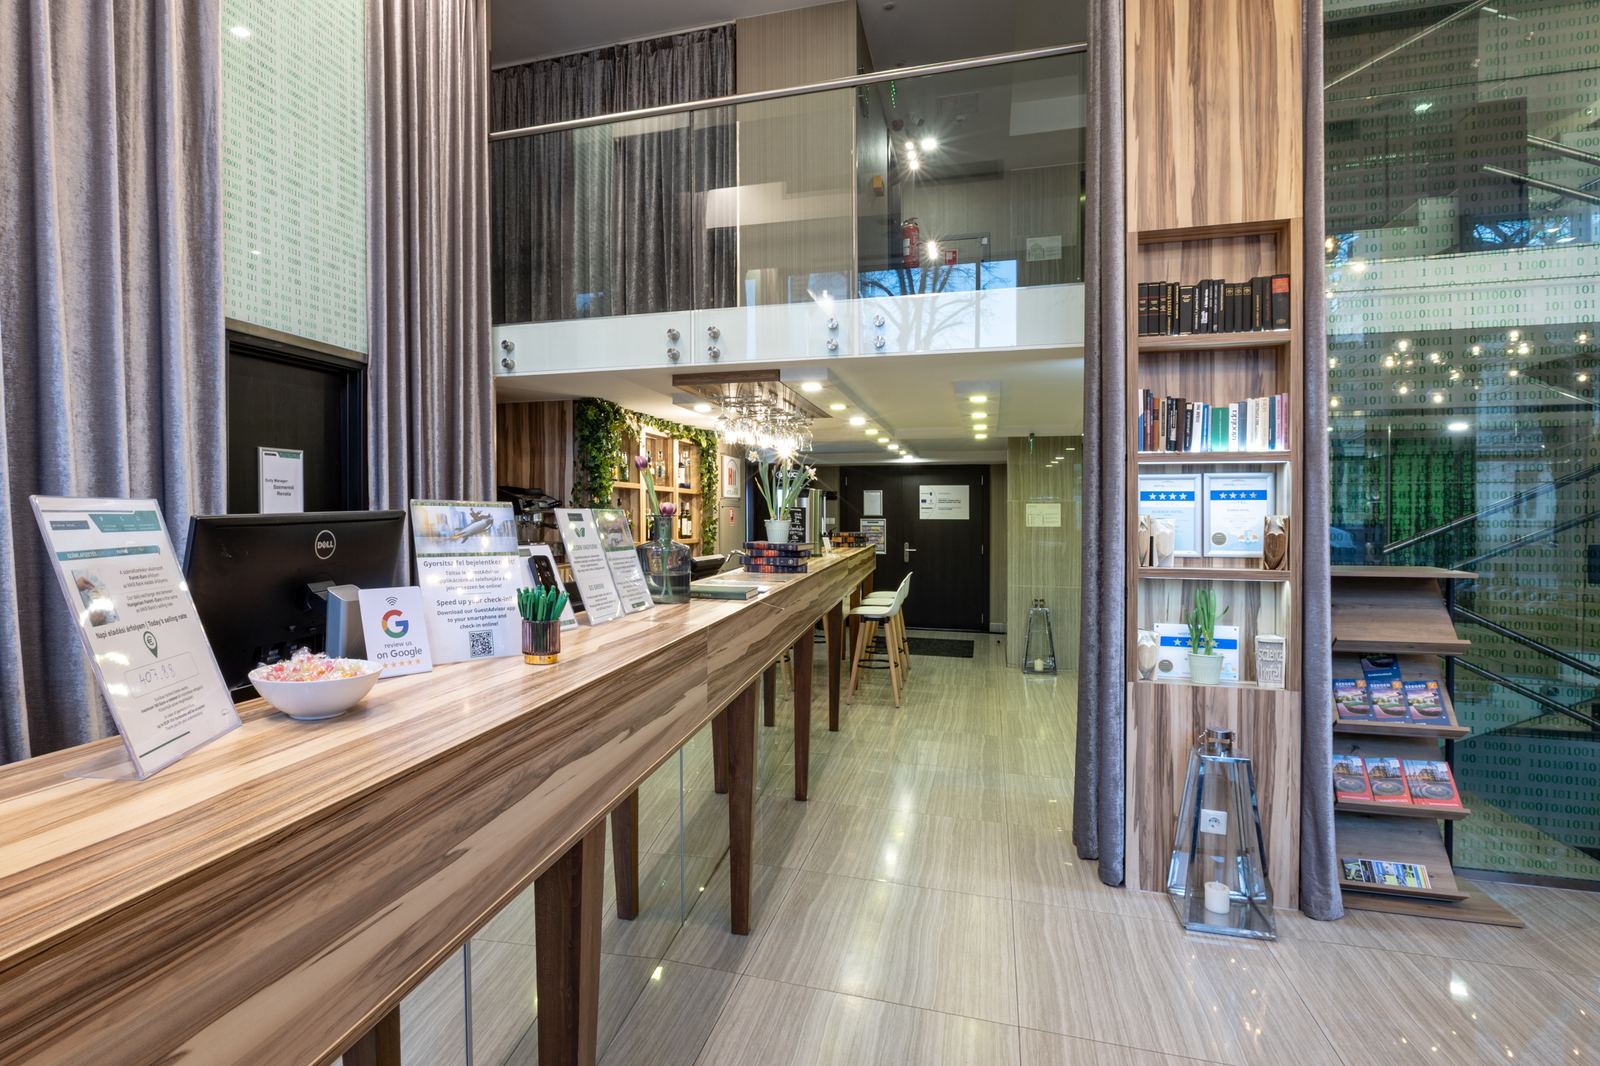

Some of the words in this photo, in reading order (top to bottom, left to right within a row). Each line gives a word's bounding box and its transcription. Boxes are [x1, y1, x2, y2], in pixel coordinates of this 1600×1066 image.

[317, 540, 334, 549] DELL
[436, 599, 457, 607] Speed
[468, 598, 482, 606] yr
[377, 652, 388, 660] on
[390, 646, 422, 658] Google
